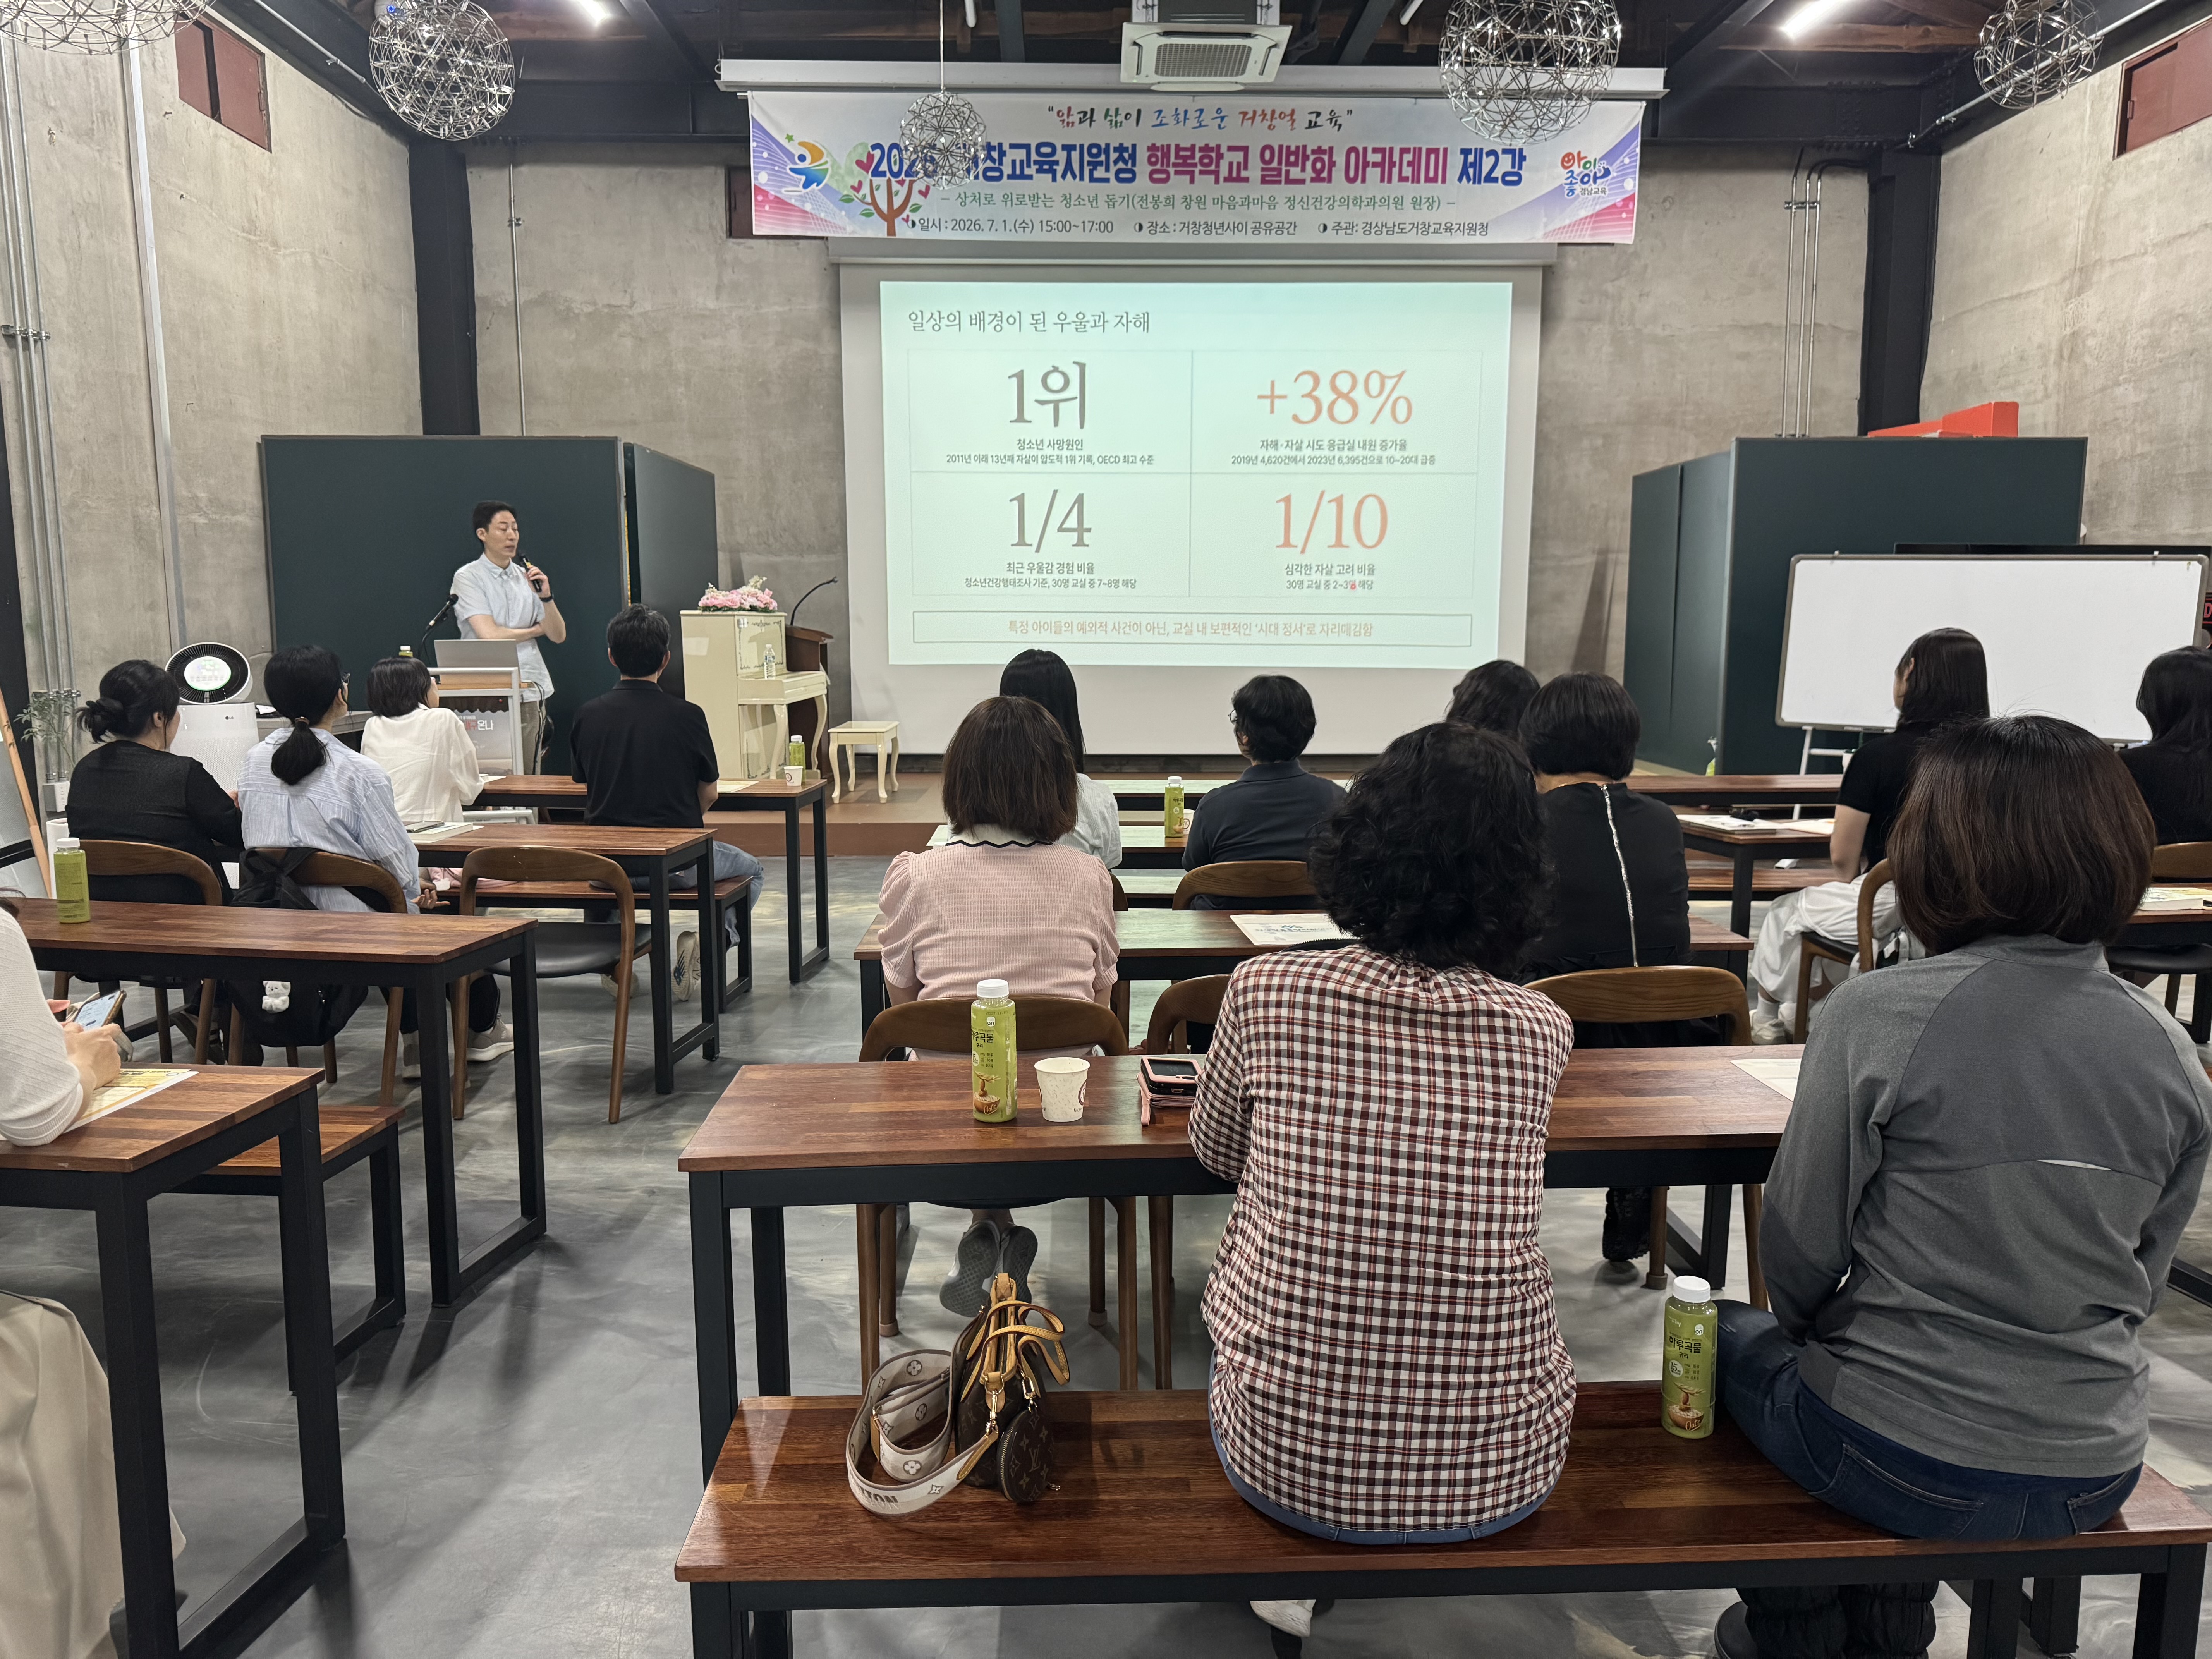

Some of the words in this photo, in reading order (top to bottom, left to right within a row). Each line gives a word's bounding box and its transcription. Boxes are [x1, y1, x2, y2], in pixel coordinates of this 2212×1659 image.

[1104, 107, 1142, 129] 삶이
[1151, 107, 1229, 130] 조화로운
[1146, 143, 1249, 185] 행복학교
[1260, 144, 1336, 185] 일반화
[1345, 146, 1448, 184] 아카데미
[1457, 148, 1526, 187] 제2강
[1580, 187, 1607, 196] 경남교육
[955, 192, 996, 208] 상처로
[1001, 192, 1055, 208] 위로받는
[1060, 193, 1099, 209] 청소년
[1180, 194, 1207, 211] 창원
[1212, 194, 1278, 211] 마음과마음
[1283, 194, 1404, 211] 정신건강의학과의원
[1410, 194, 1441, 212] 원장)
[1039, 220, 1114, 234] 15:00~17:00
[1179, 220, 1247, 235] 거창청년사이
[1250, 221, 1297, 236] 공유공간
[1361, 221, 1489, 236] 경상남도거창교육지원청
[908, 310, 962, 333] 일상의
[969, 310, 1022, 333] 배경이
[1029, 311, 1047, 333] 된
[1053, 311, 1108, 333] 우울과
[1113, 311, 1150, 334] 자해
[1008, 361, 1087, 429] 1위
[1257, 369, 1413, 425] +38%
[1017, 439, 1044, 451] 청소년
[1047, 439, 1084, 451] 사망원인
[1306, 439, 1325, 452] 시도
[1327, 439, 1356, 452] 응급실
[1358, 439, 1376, 452] 내원
[1379, 439, 1407, 452] 증가율
[946, 454, 971, 465] 2011년
[973, 454, 988, 465] 이래
[1097, 454, 1120, 465] OECD
[1123, 454, 1137, 465] 최고
[1139, 454, 1154, 465] 수준
[1231, 455, 1258, 465] 2019년
[1307, 455, 1335, 465] 2023년
[1008, 489, 1092, 553] 1/4
[1275, 490, 1389, 555] 1/10
[1007, 562, 1024, 574] 최근
[1027, 562, 1054, 574] 우울감
[1056, 562, 1074, 574] 경험
[1077, 562, 1094, 574] 비율
[1285, 563, 1312, 576] 심각한
[1315, 563, 1333, 576] 자살
[1336, 563, 1354, 576] 고려
[1357, 563, 1375, 576] 비율
[1052, 577, 1070, 589] 30명
[1072, 577, 1086, 589] 교실
[1088, 577, 1096, 589] 중
[1122, 577, 1137, 589] 해당
[1286, 580, 1304, 590] 30명
[1306, 580, 1321, 590] 교실
[1324, 580, 1331, 590] 중
[1358, 580, 1374, 590] 해당
[1009, 620, 1029, 635] 특정
[1032, 620, 1073, 635] 아이들의
[1077, 620, 1108, 635] 예외적
[1111, 621, 1142, 635] 사건이
[1173, 621, 1193, 635] 교실
[1197, 622, 1207, 637] 내
[1211, 622, 1252, 637] 보편적인
[1319, 622, 1373, 637] 자리매김함
[984, 1104, 997, 1115] Oats
[1669, 1336, 1701, 1353] 하루곡물
[1685, 1420, 1700, 1431] Oats
